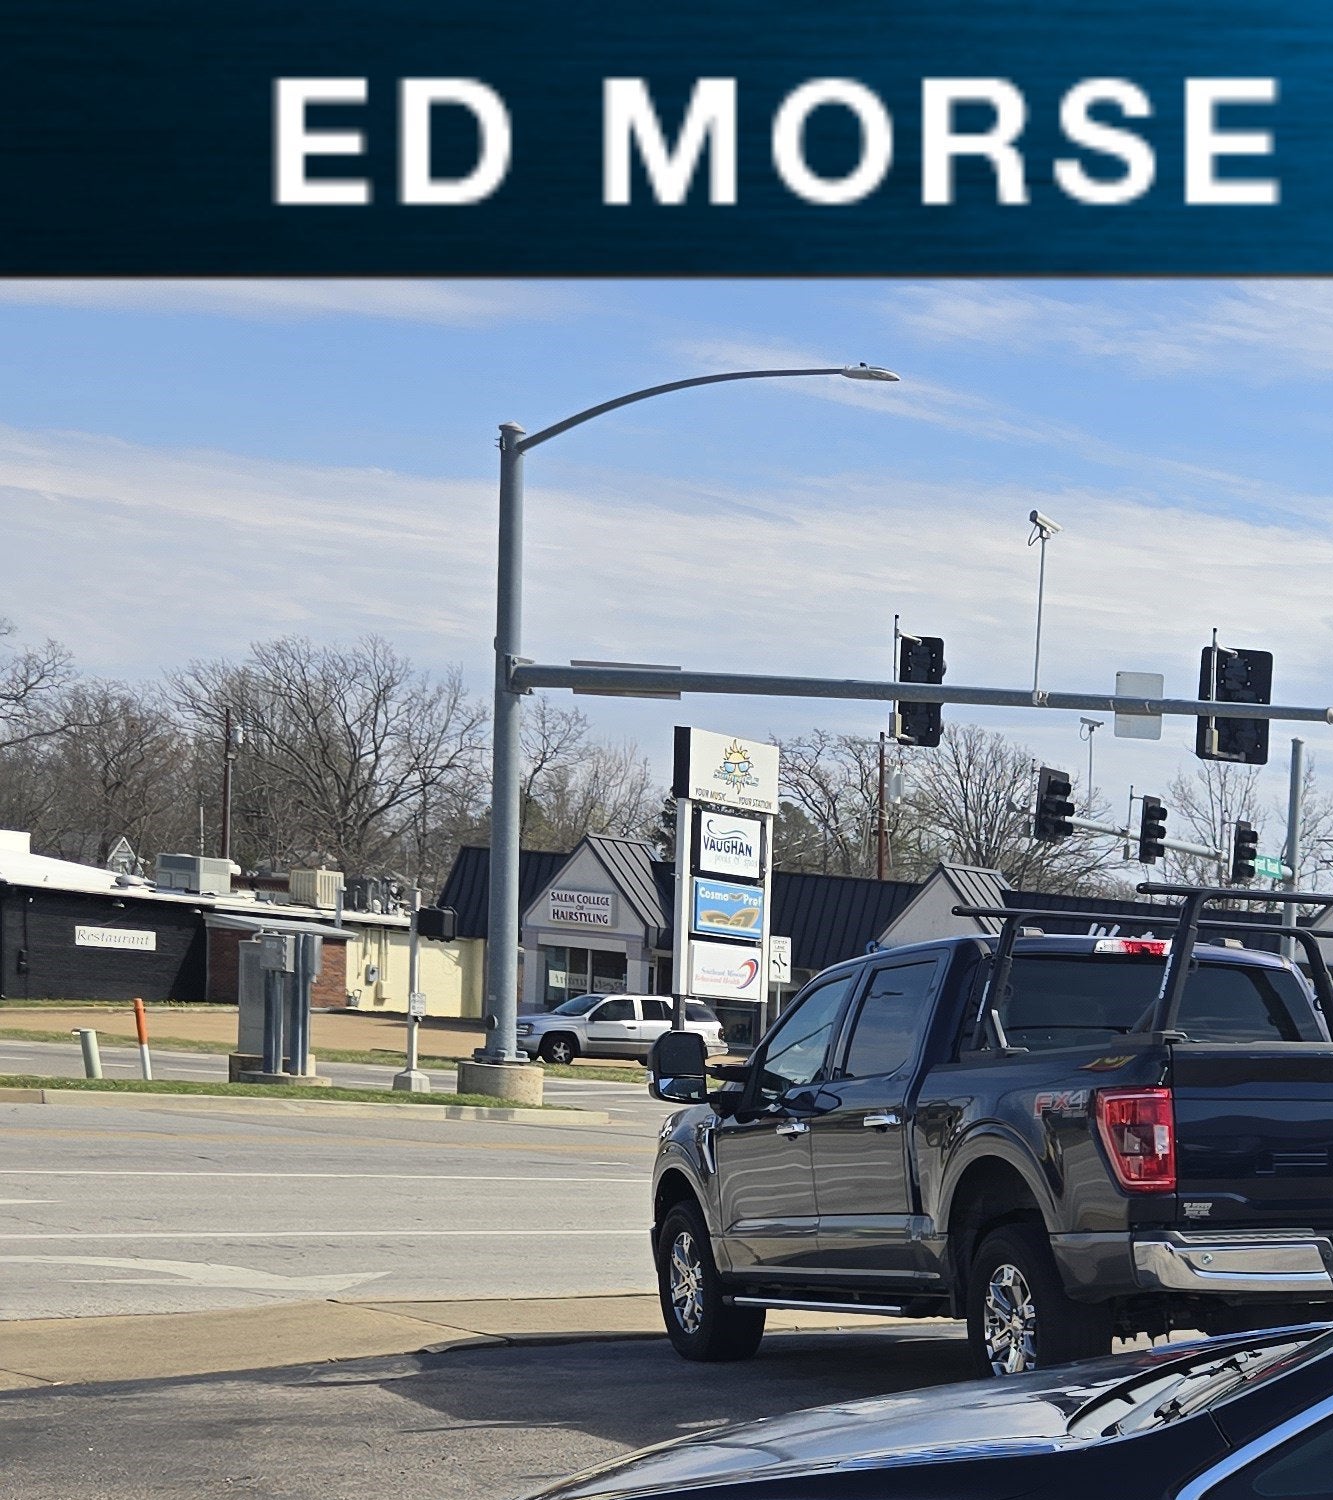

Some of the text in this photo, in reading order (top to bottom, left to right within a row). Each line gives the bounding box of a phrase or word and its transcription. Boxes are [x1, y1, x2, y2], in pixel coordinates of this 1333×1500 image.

[703, 835, 752, 857] VAUGHAN
[551, 891, 610, 907] SALEM COLLEGE
[552, 909, 609, 925] HAIRSTYLING
[77, 929, 150, 946] Restaurant
[1034, 1090, 1088, 1117] FX4
